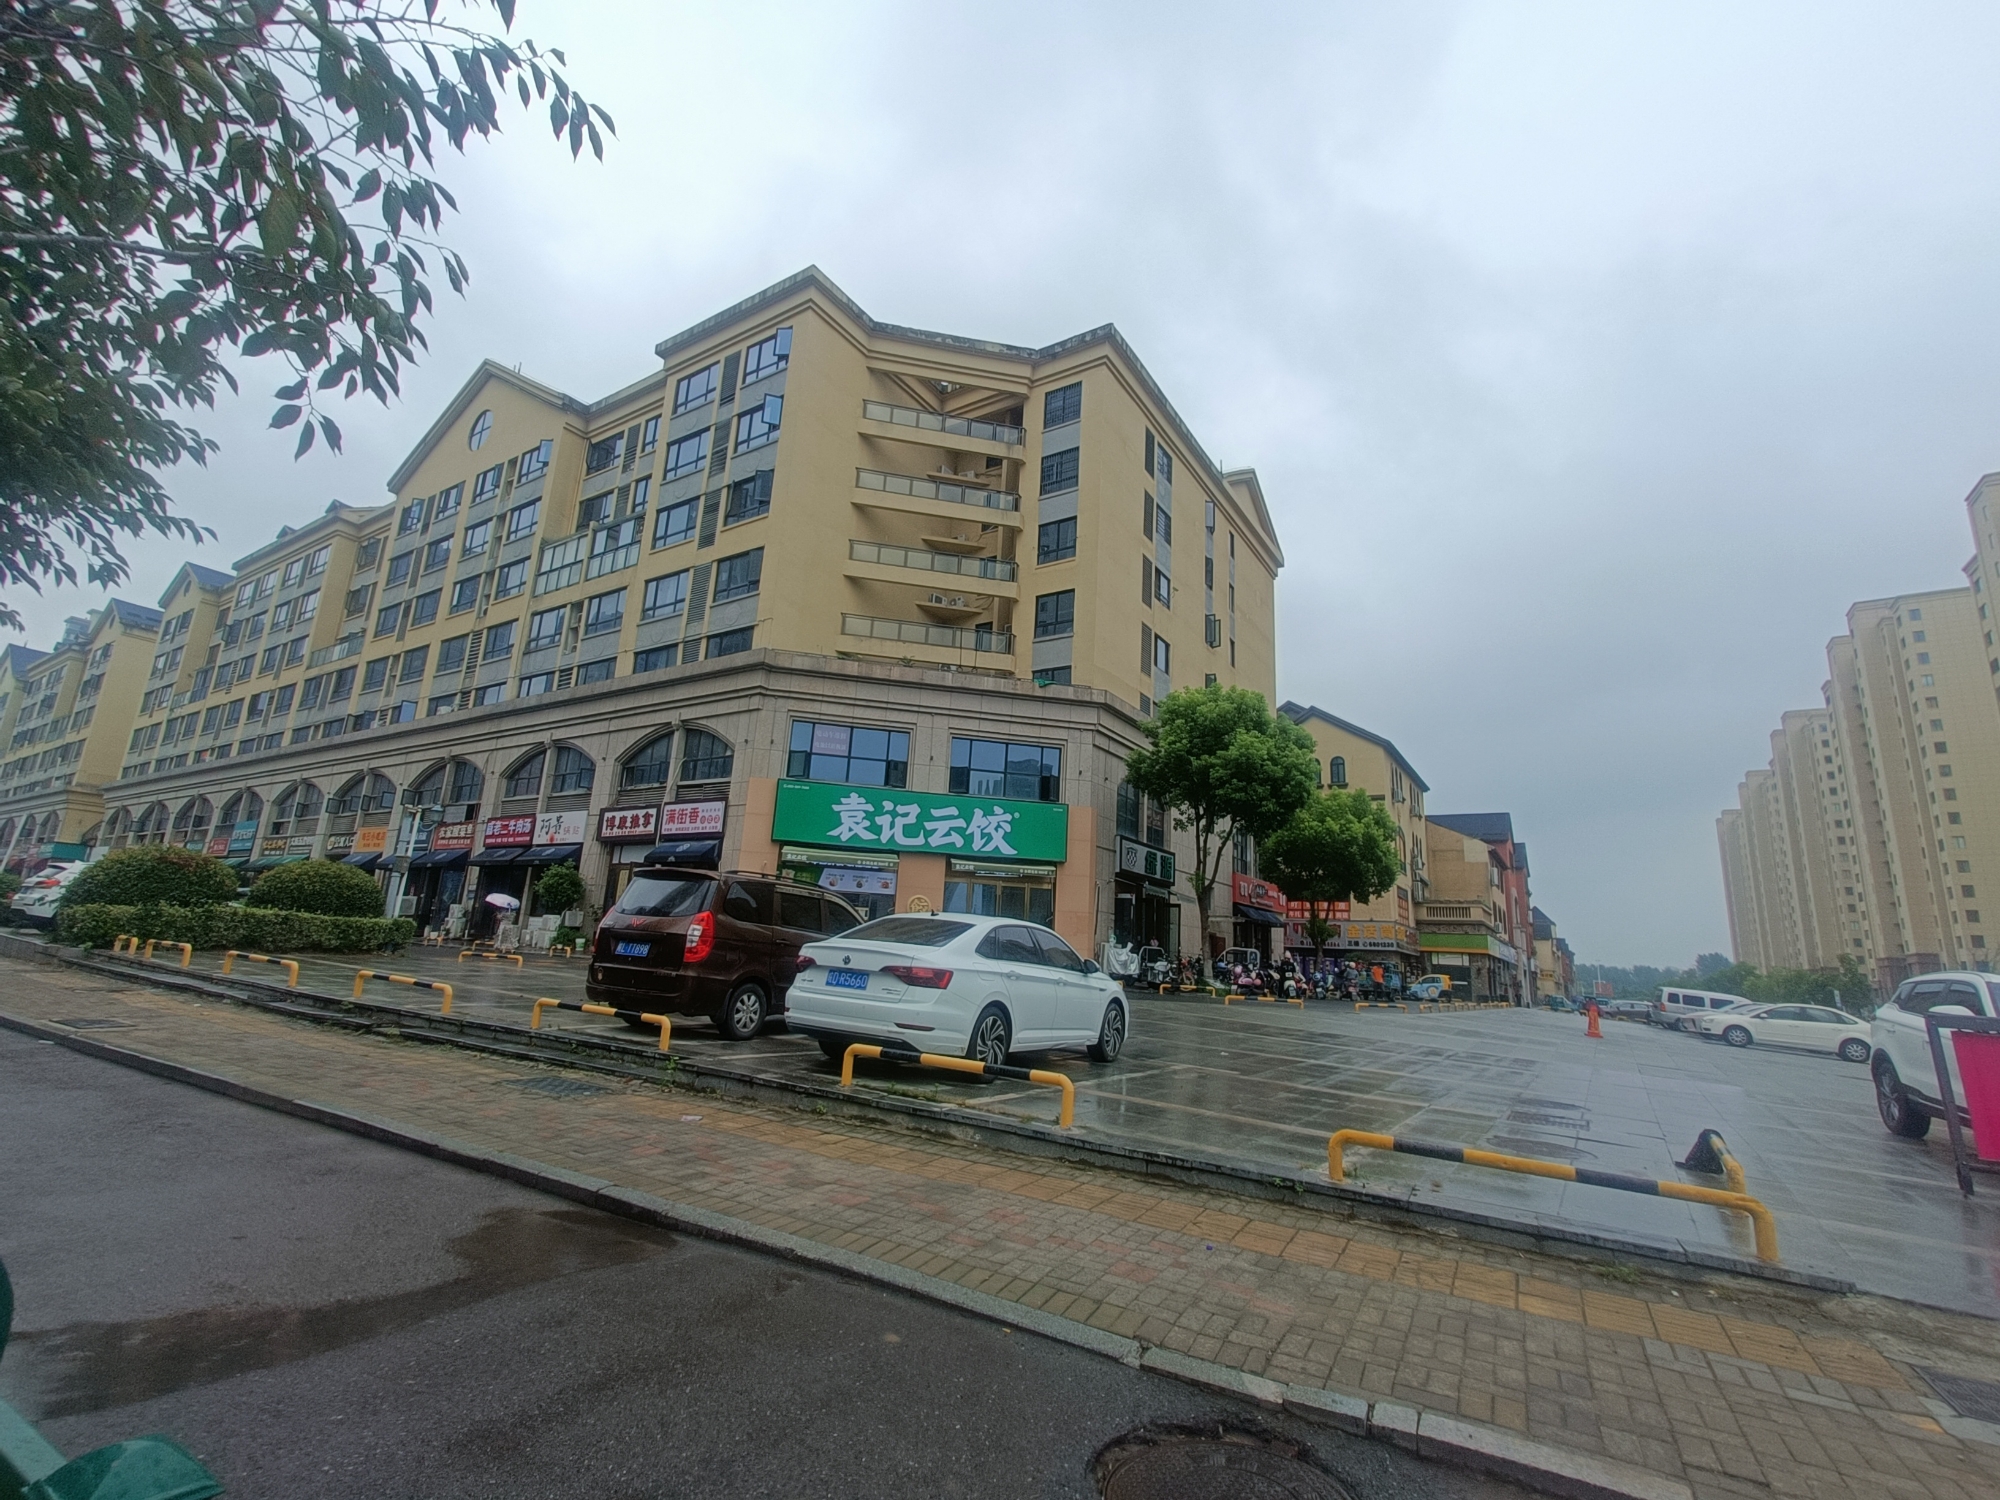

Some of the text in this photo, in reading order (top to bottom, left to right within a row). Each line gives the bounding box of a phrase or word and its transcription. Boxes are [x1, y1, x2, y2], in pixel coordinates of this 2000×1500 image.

[605, 811, 654, 831] 博康推拿
[665, 807, 699, 825] 满街香
[826, 792, 1018, 855] 袁记云饺
